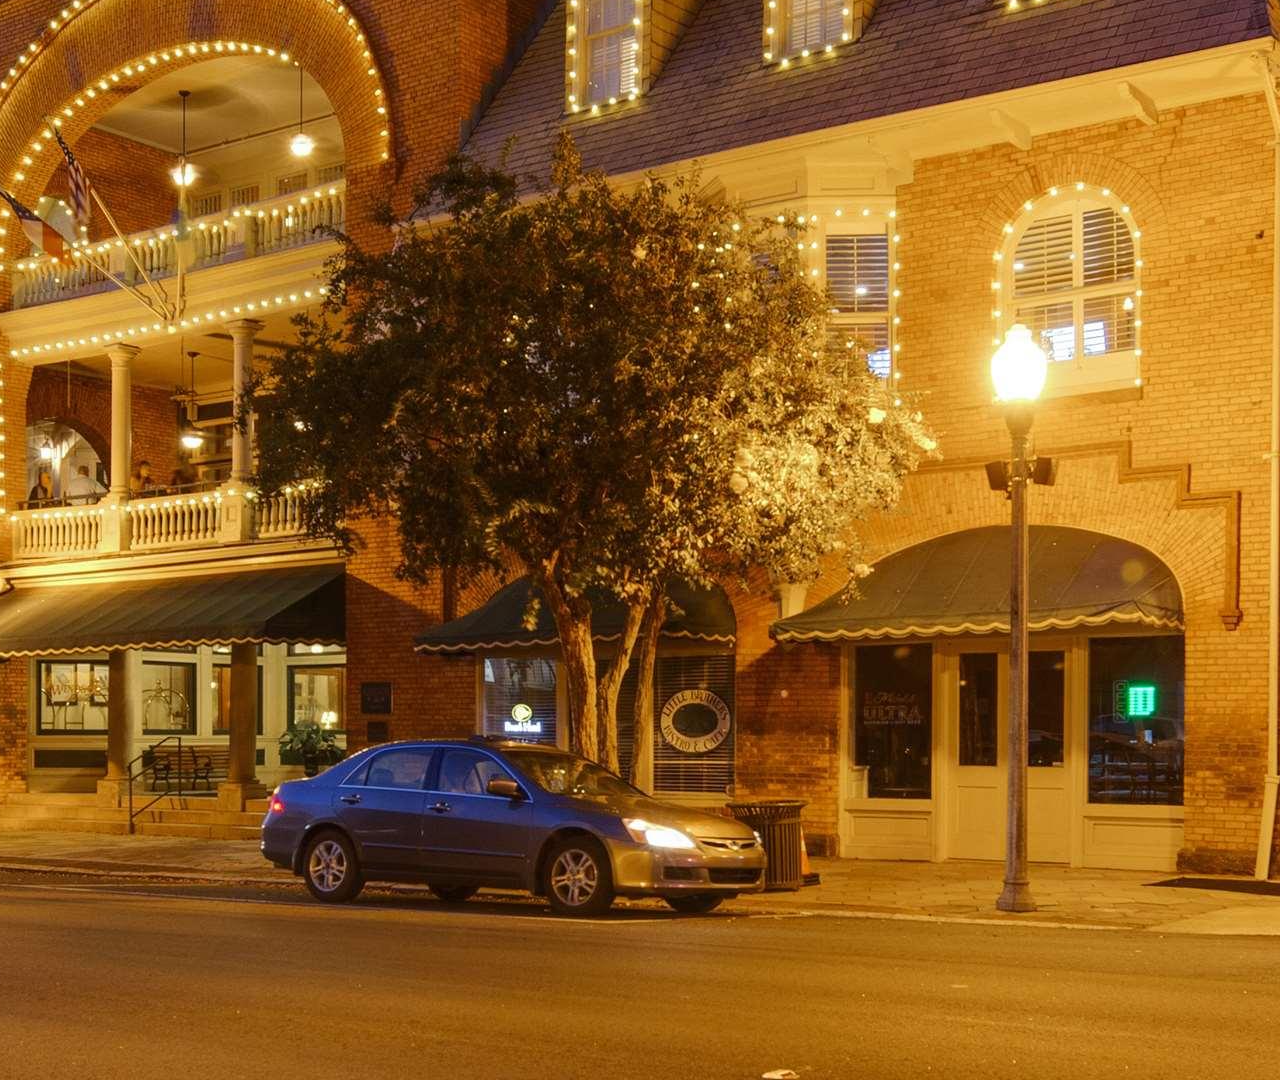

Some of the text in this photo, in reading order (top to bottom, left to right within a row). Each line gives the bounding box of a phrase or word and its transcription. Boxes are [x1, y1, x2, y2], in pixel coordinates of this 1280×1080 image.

[662, 693, 687, 717] LITTLE
[864, 705, 922, 720] ULTRA
[664, 725, 690, 751] BISTRO
